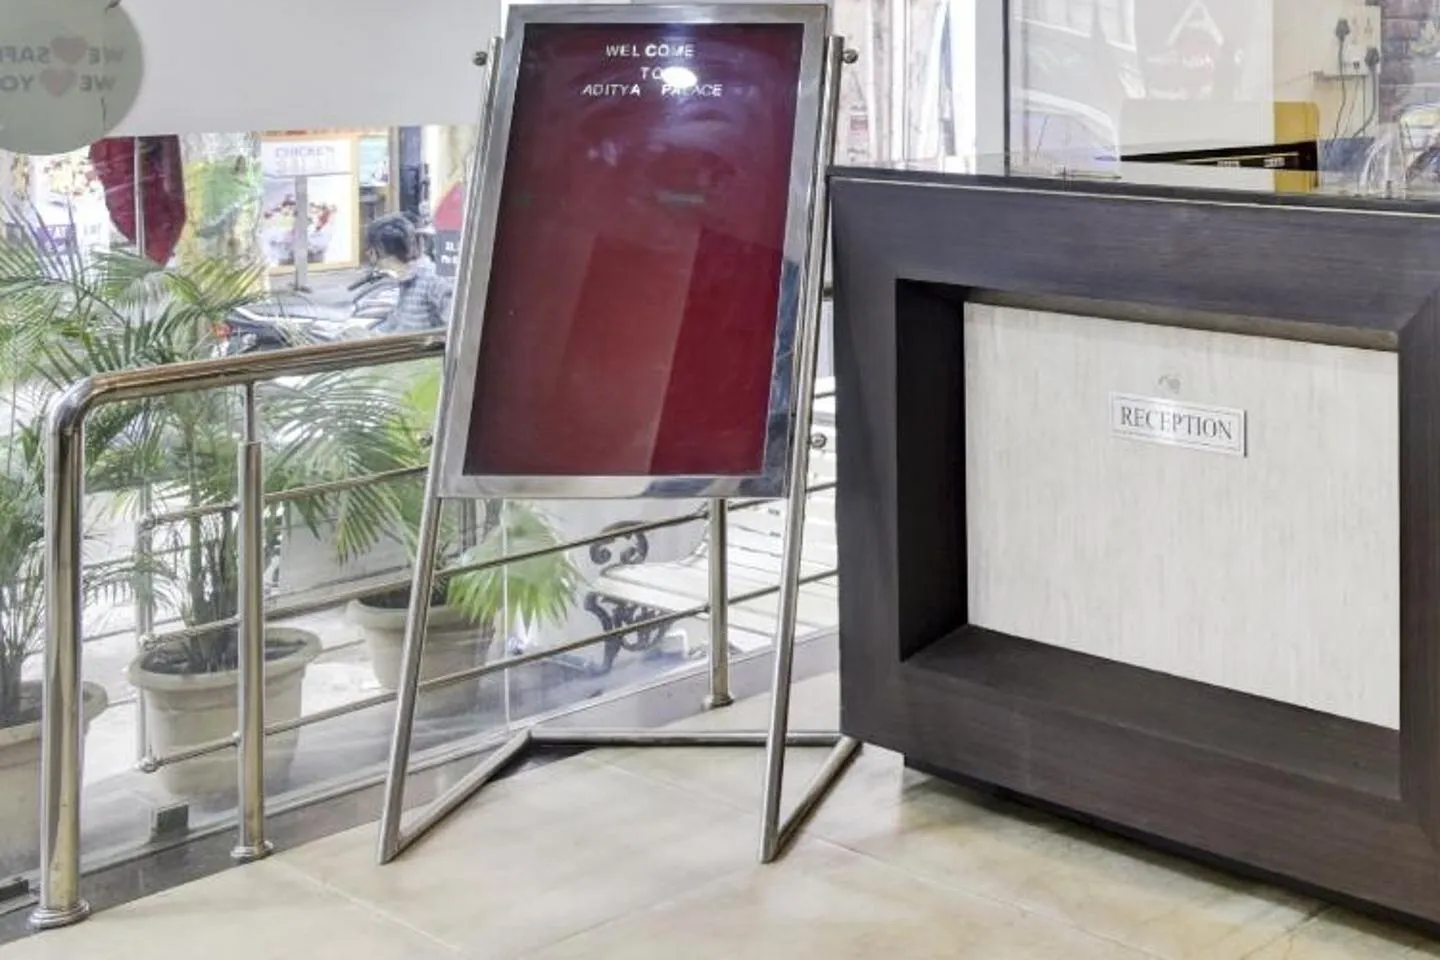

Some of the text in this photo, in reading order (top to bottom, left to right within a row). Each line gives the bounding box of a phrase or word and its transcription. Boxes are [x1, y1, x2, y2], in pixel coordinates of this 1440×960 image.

[640, 66, 663, 80] TO
[583, 83, 641, 97] ADITYA
[1120, 406, 1233, 441] RECEPTION
